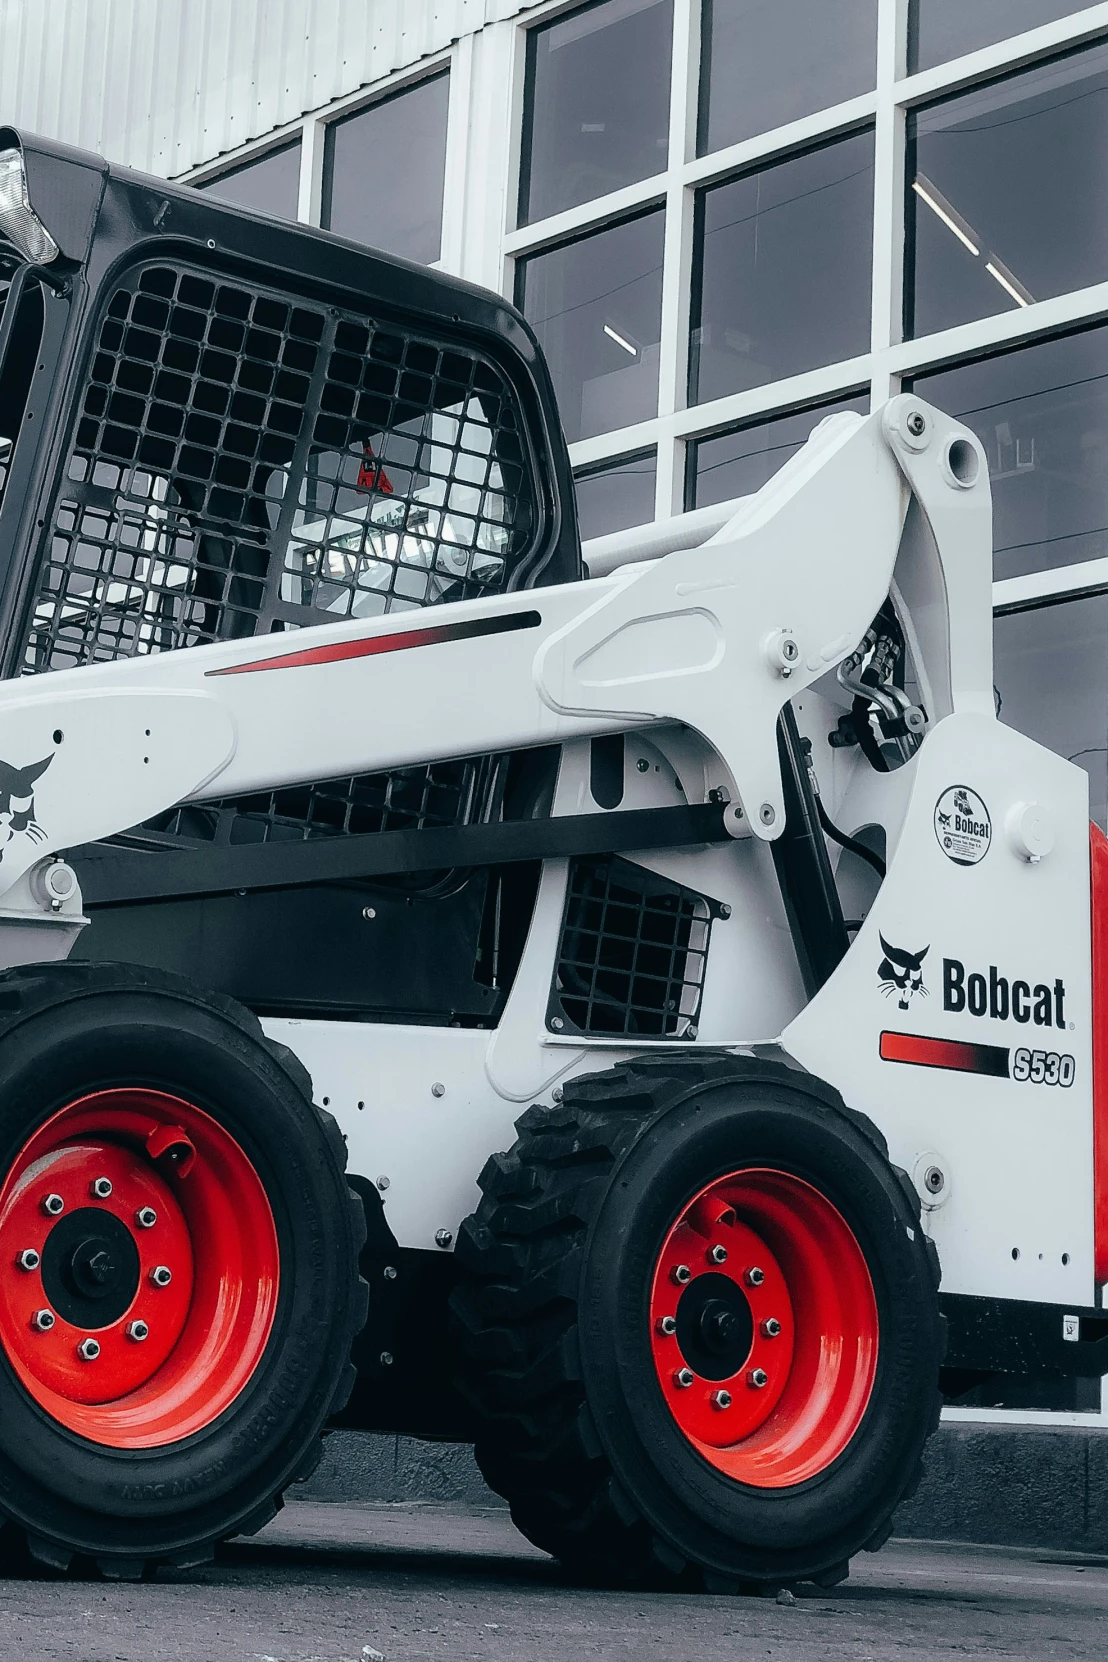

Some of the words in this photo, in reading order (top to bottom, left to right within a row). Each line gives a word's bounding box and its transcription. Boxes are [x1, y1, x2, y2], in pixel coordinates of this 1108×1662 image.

[954, 814, 989, 838] Bobcat
[942, 957, 1066, 1030] Bobcat
[1013, 1047, 1076, 1088] S530
